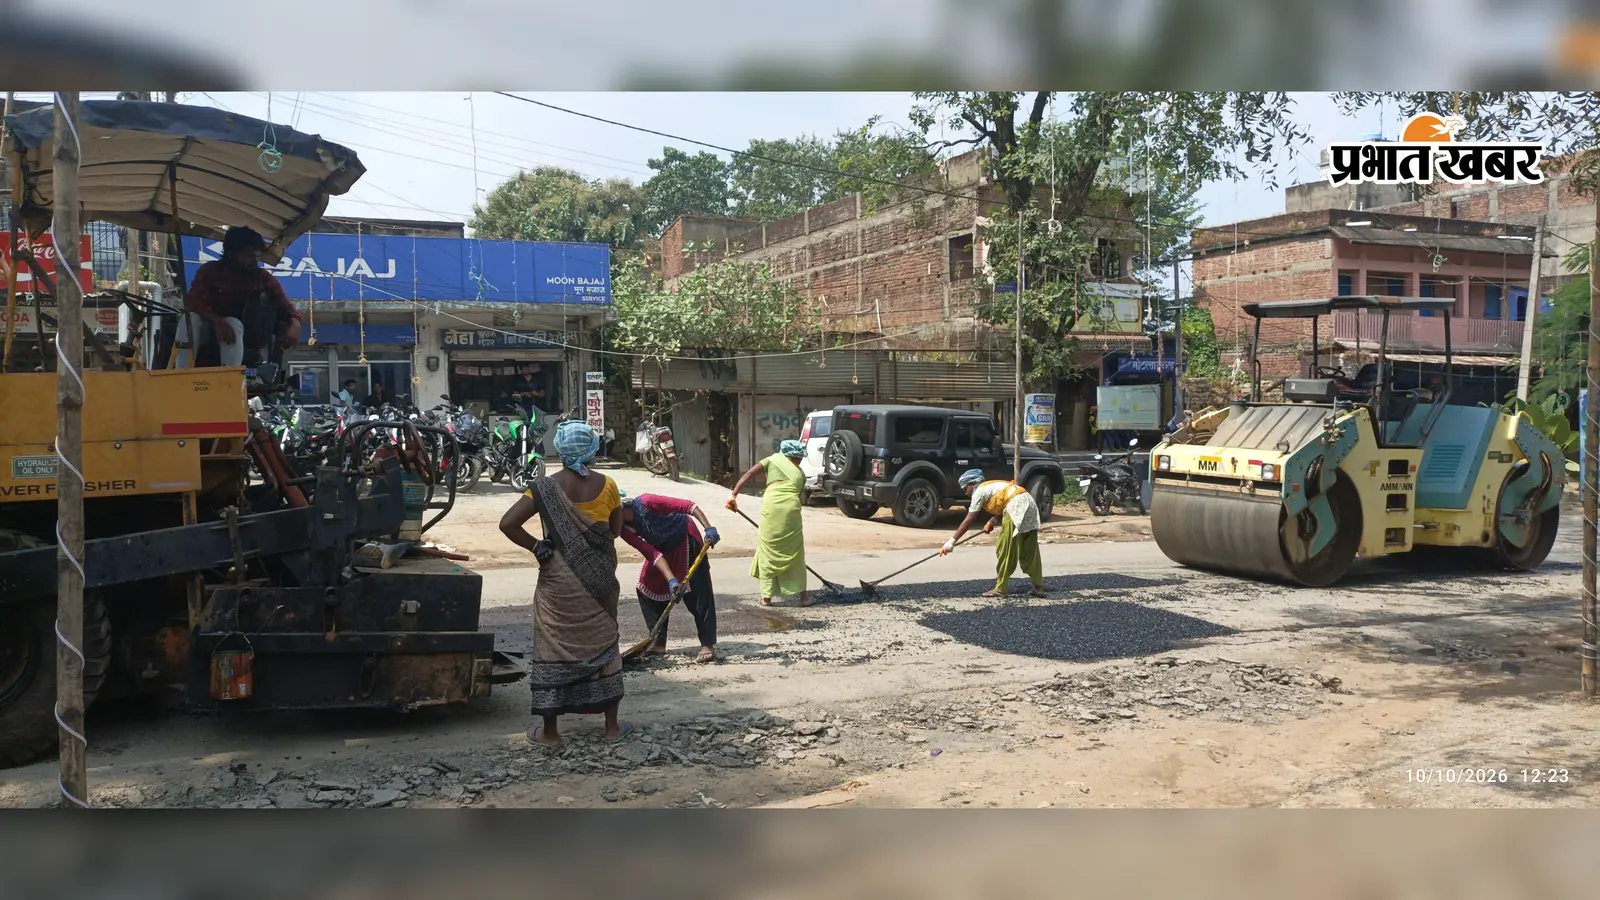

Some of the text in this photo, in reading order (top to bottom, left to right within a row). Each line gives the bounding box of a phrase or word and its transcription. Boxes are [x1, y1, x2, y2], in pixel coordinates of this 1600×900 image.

[264, 257, 396, 279] BAJAJ
[546, 277, 605, 285] MOON BAJAJ
[444, 329, 474, 346] नेहा
[35, 466, 54, 474] ONLY
[0, 479, 137, 496] VER FSHER
[1380, 482, 1413, 491] AMMANN
